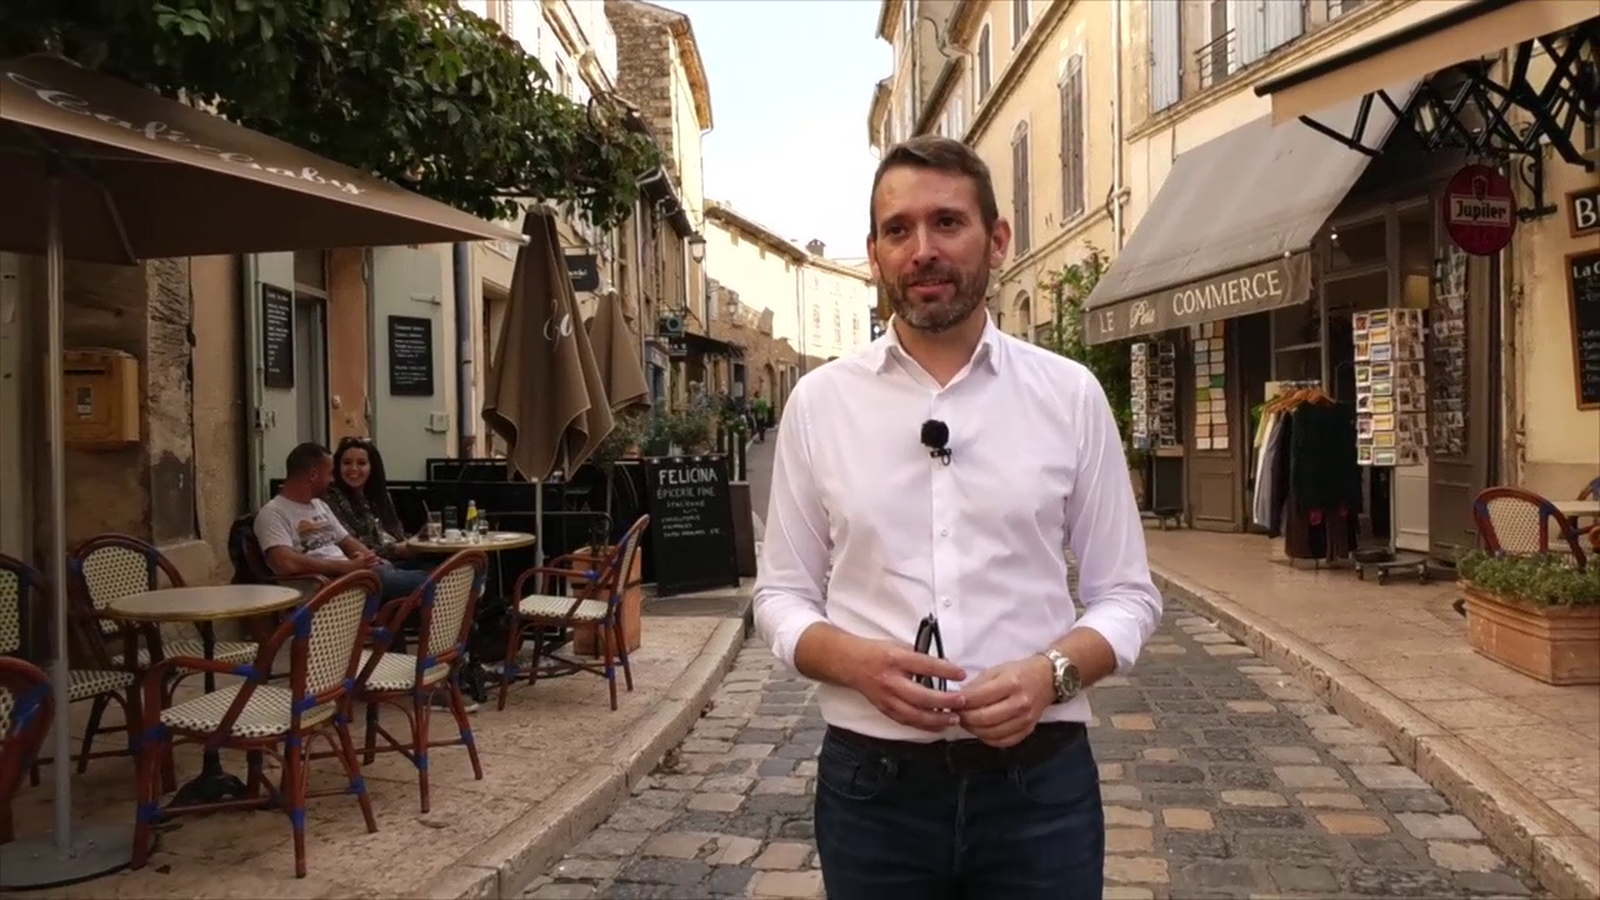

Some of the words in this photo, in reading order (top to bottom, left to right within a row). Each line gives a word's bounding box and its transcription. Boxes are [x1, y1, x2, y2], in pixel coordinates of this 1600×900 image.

[1456, 200, 1507, 221] Jupiler
[1100, 311, 1114, 334] LE
[1172, 269, 1282, 316] COMMERCE
